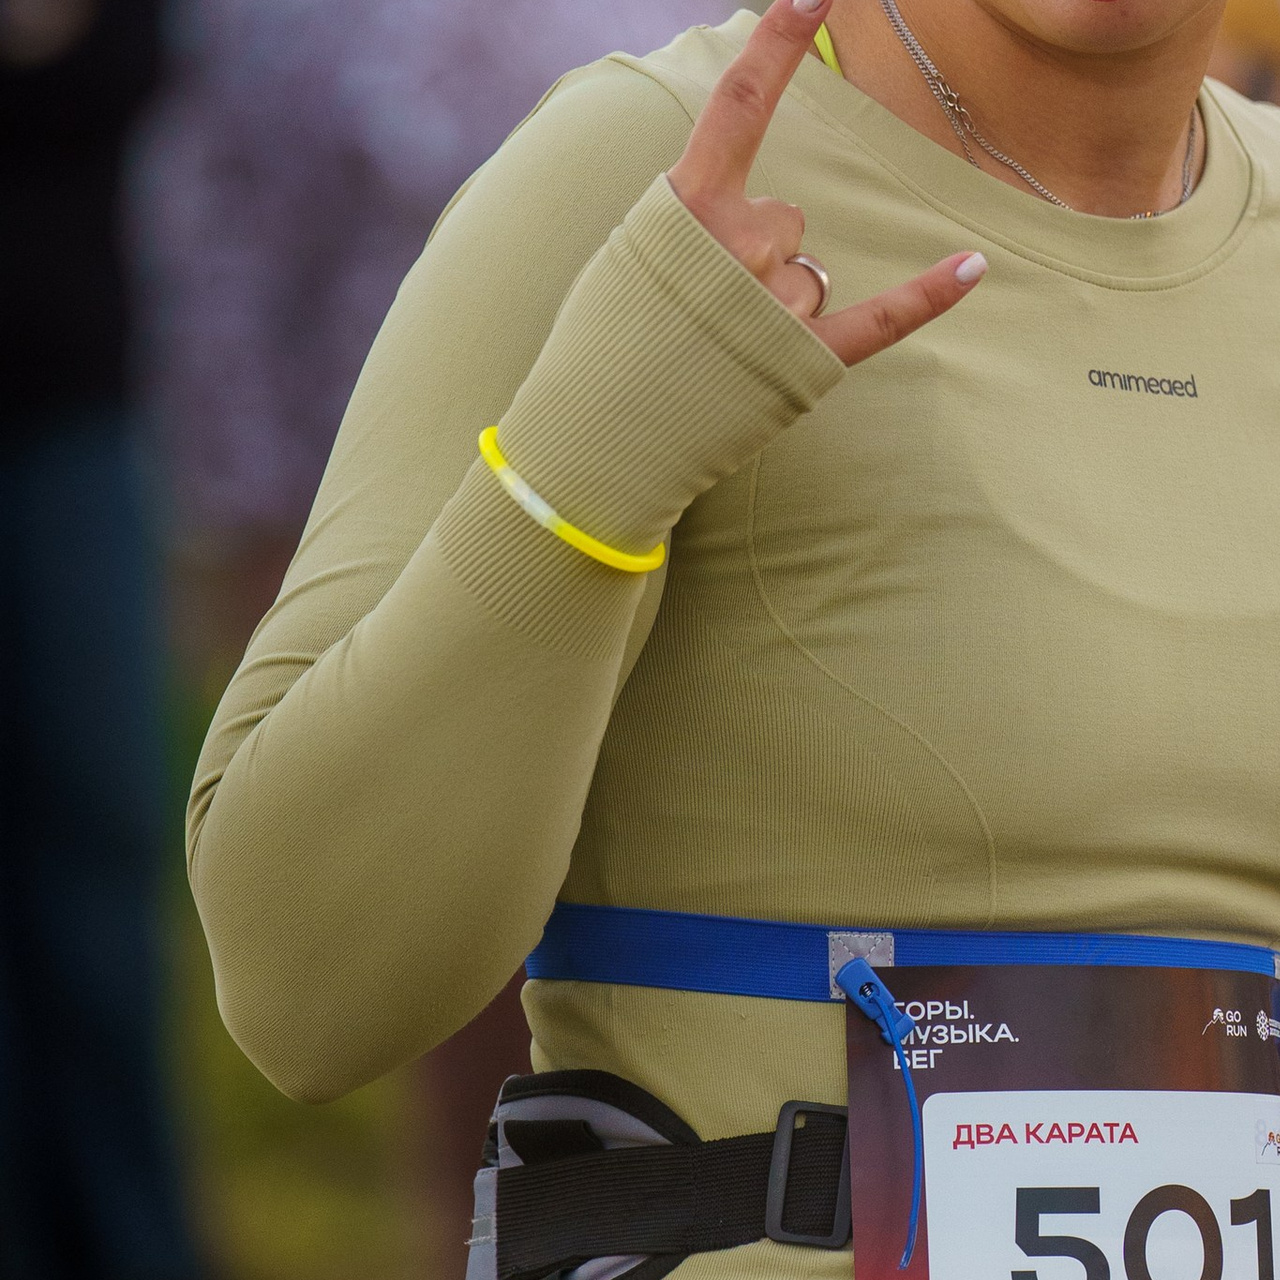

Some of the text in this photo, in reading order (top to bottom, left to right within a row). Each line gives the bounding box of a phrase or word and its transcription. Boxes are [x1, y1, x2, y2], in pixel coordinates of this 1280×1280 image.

[1225, 1010, 1242, 1023] GO
[1226, 1024, 1247, 1037] RUN
[952, 1122, 1139, 1150] ДВА КАРАТА
